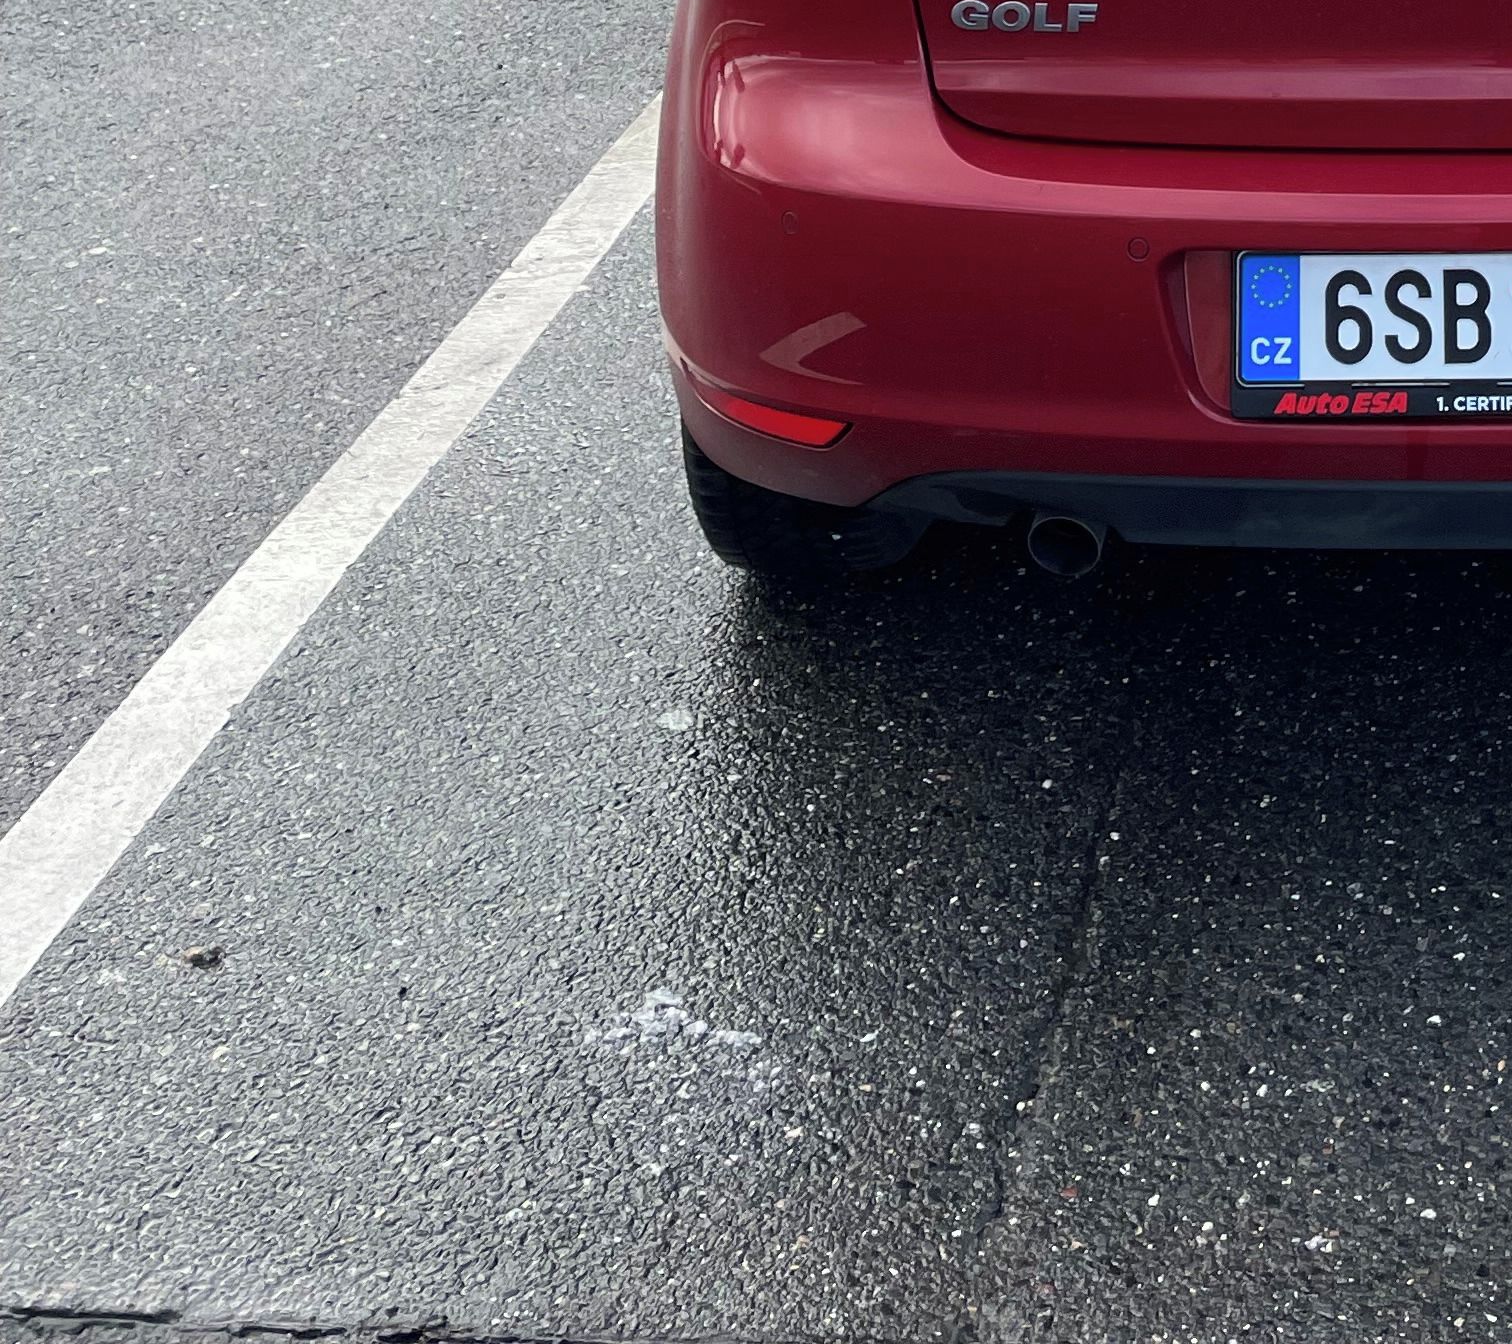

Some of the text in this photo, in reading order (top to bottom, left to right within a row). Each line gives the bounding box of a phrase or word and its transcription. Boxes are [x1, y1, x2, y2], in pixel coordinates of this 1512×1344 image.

[951, 0, 1099, 33] GOLF
[1323, 269, 1493, 365] 6SB
[1250, 336, 1292, 366] CZ
[1274, 391, 1408, 414] Auto ESA
[1437, 397, 1449, 411] 1.
